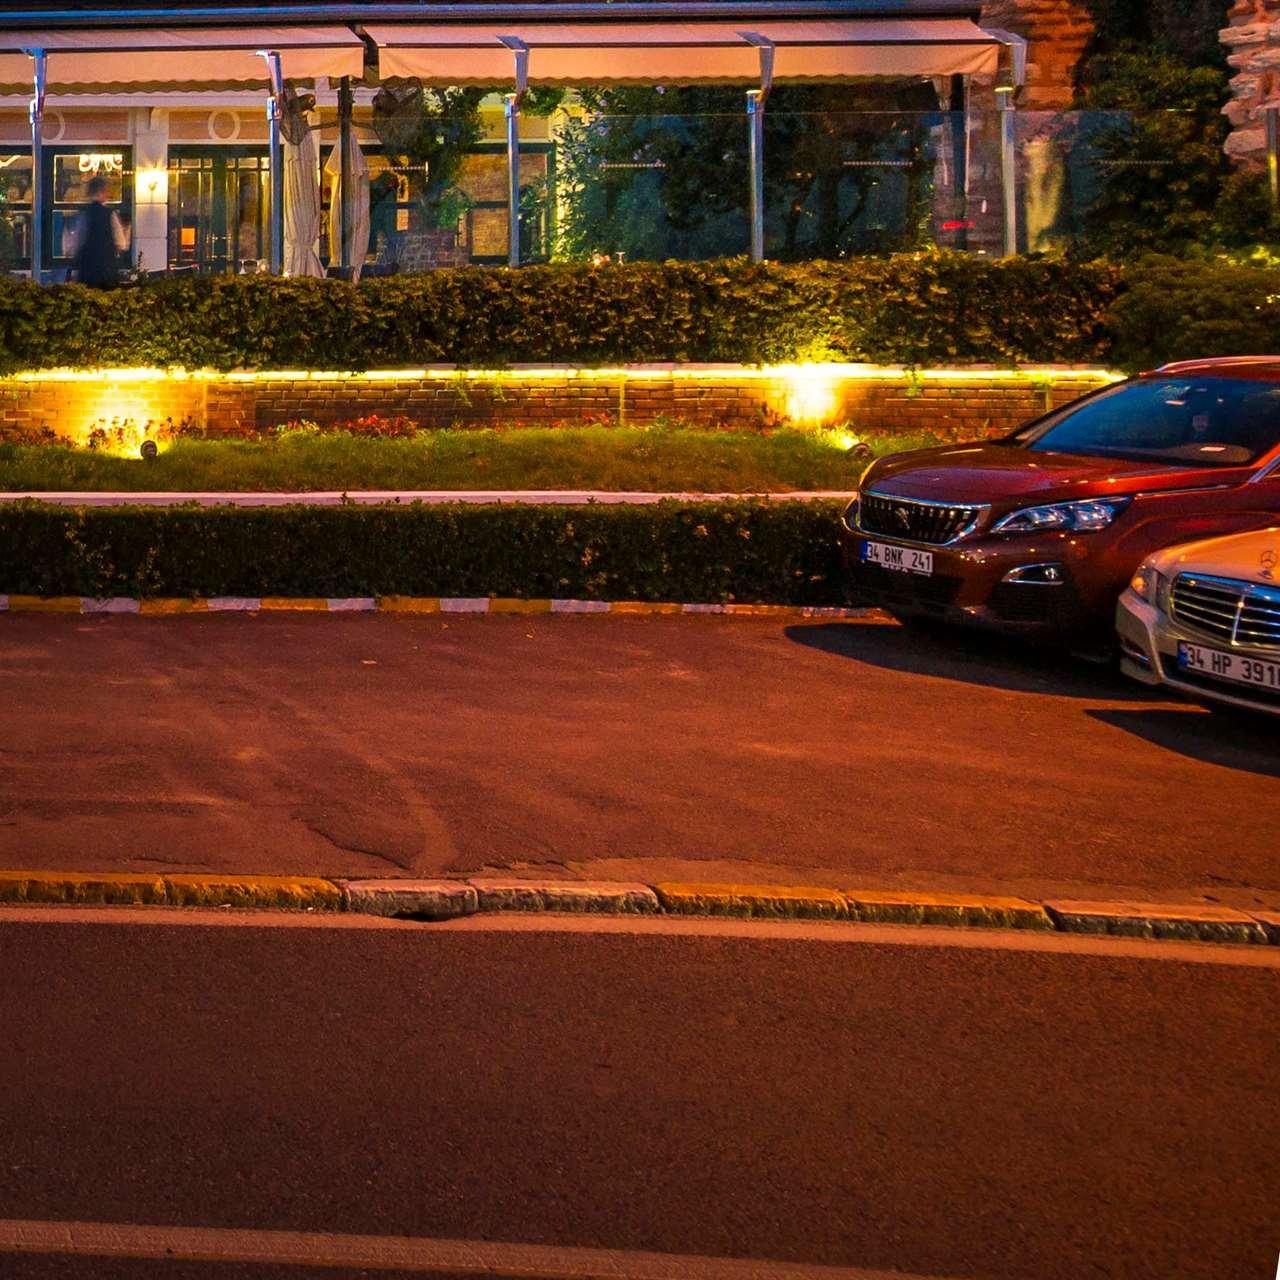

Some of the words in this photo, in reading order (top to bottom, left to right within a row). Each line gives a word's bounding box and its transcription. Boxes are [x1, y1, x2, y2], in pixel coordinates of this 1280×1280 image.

[867, 543, 880, 561] 34
[884, 547, 904, 566] BNK
[911, 551, 932, 571] 241
[1187, 646, 1205, 669] 34
[1211, 652, 1232, 675] HP
[1241, 659, 1280, 686] 391
